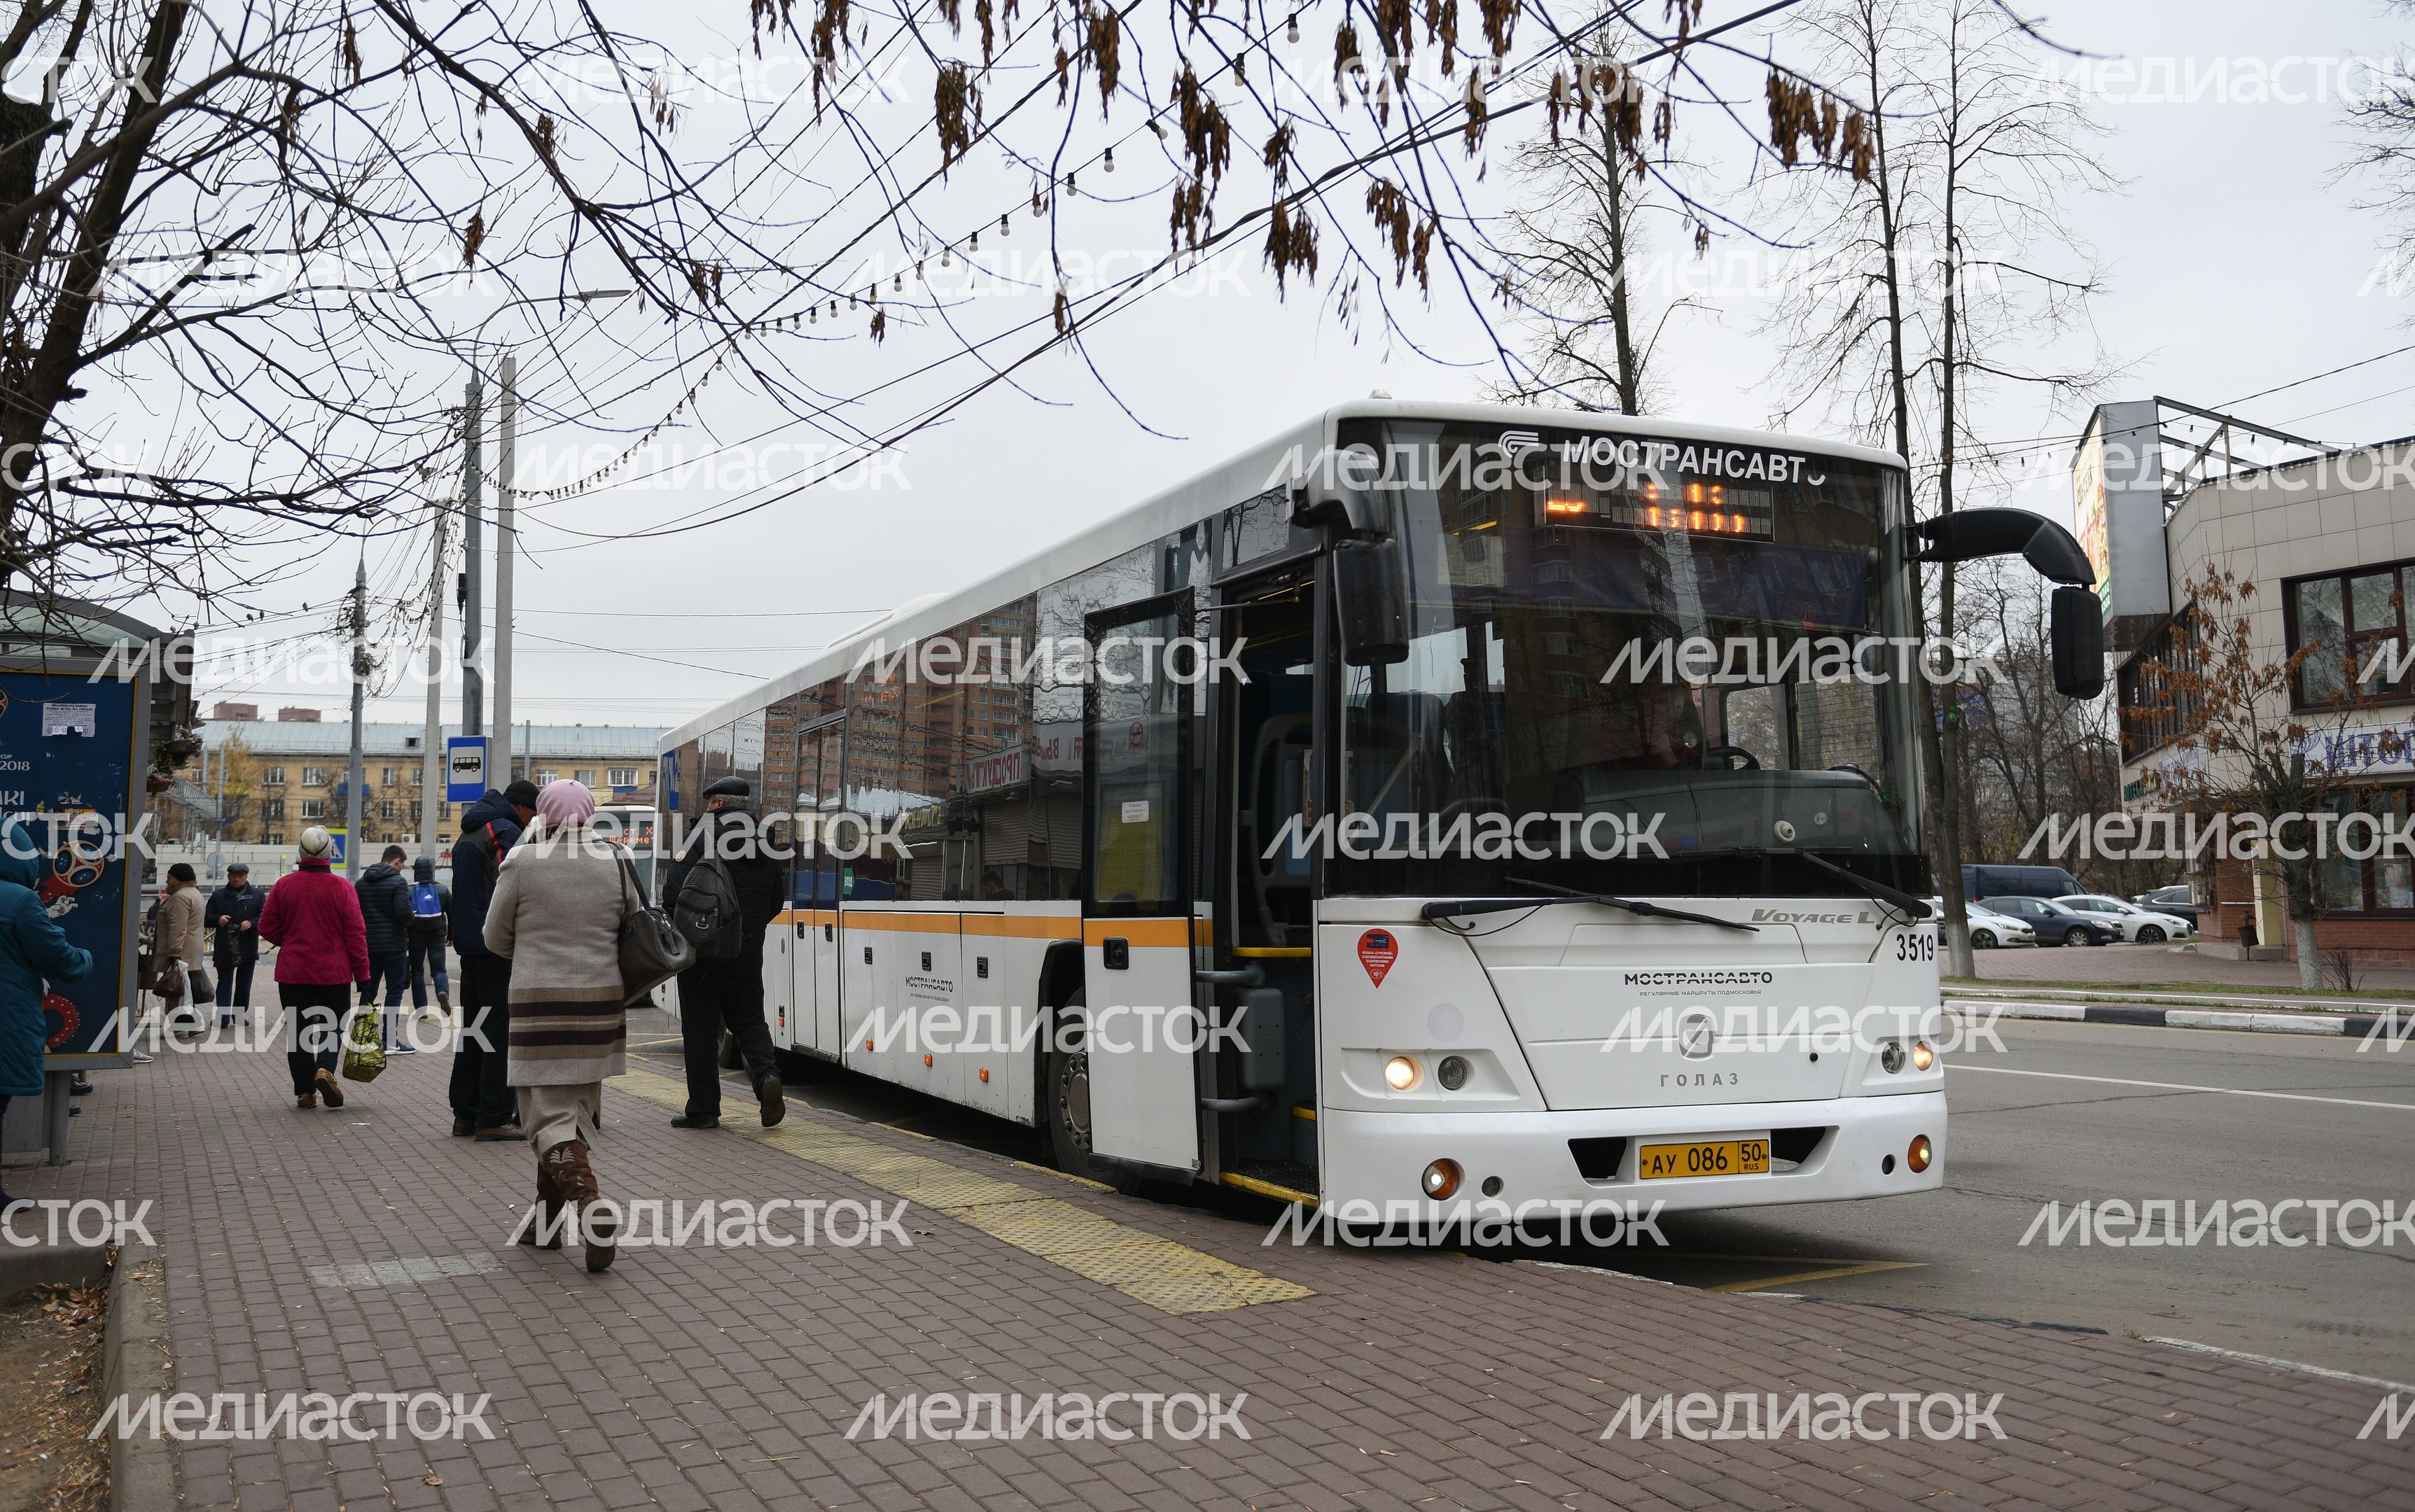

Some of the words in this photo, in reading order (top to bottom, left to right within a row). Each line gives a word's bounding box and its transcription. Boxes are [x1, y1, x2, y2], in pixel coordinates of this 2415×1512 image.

[0, 760, 30, 771] 2018
[1896, 934, 1934, 962] 3519
[1624, 972, 1773, 986] МОСТРАНСАВТО
[1660, 1072, 1739, 1087] ГОЛАЗ
[1652, 1154, 1677, 1174] АУ
[1687, 1146, 1728, 1172] 086
[1741, 1142, 1762, 1162] 50
[1744, 1162, 1759, 1170] RUS
